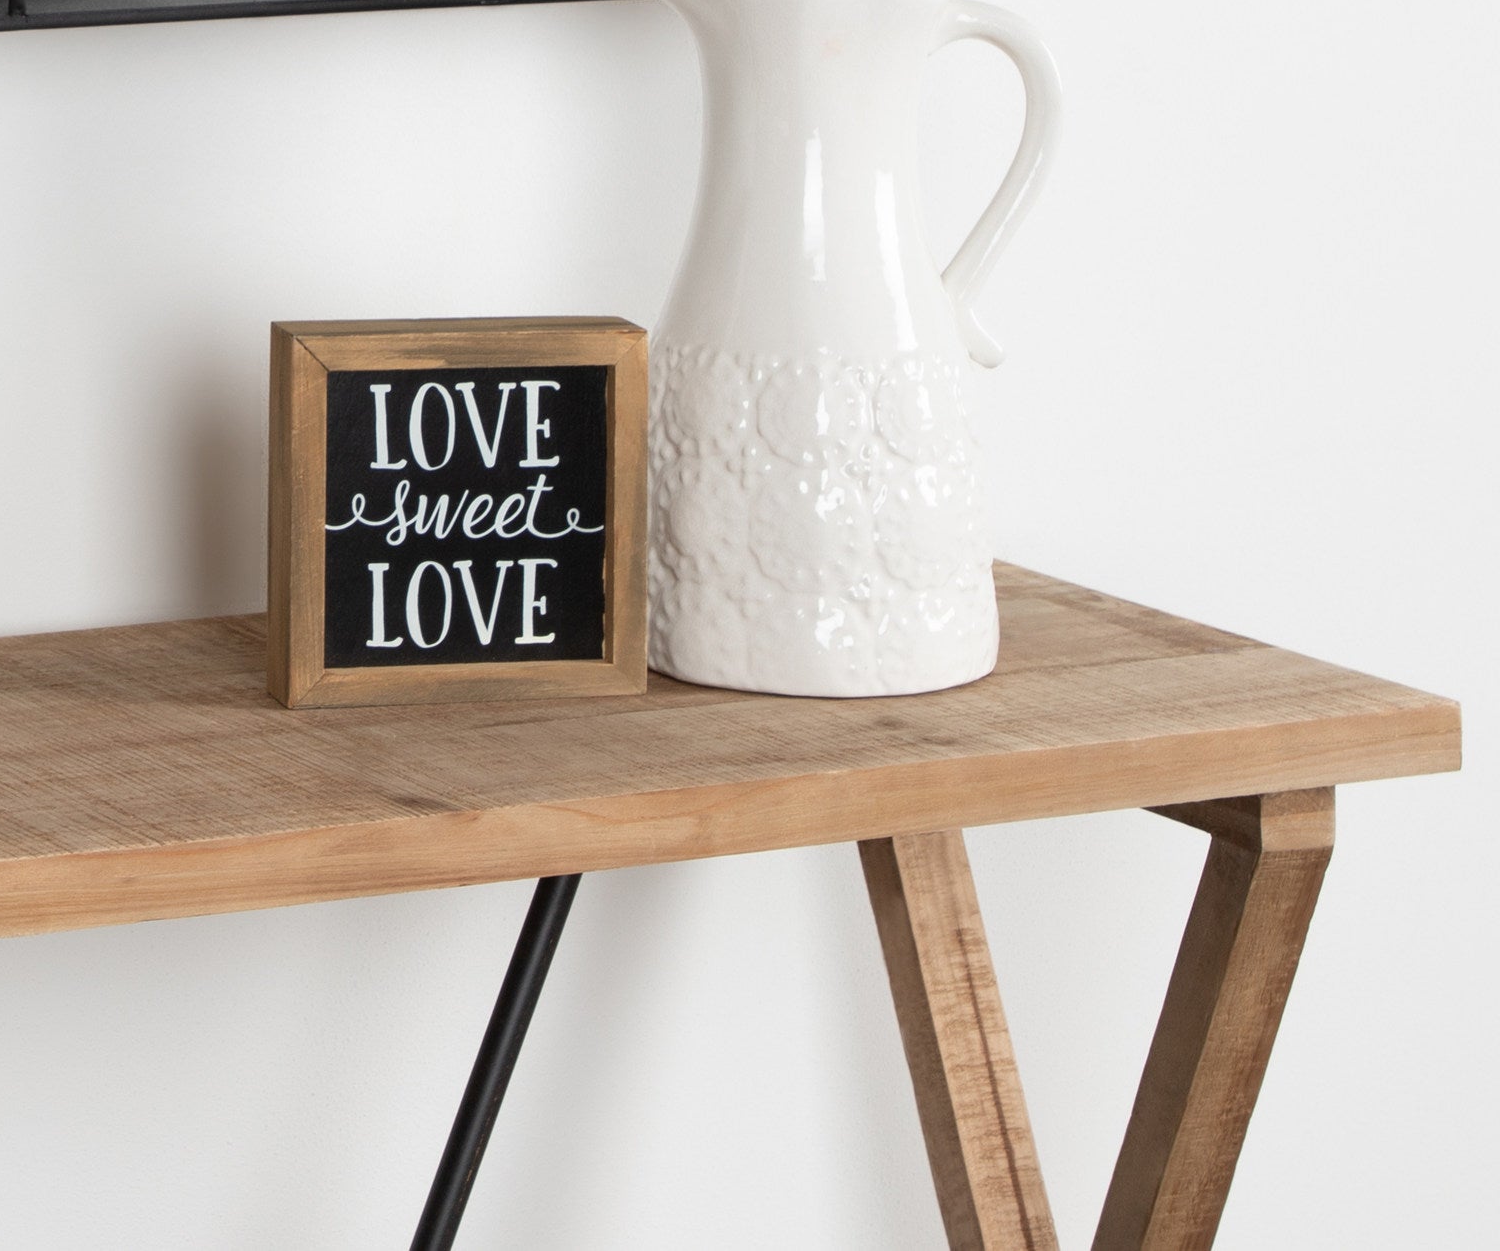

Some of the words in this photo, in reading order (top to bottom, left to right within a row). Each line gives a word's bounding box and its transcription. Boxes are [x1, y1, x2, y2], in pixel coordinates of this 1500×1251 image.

[369, 380, 561, 471] LOVE
[326, 473, 604, 546] sweet
[365, 558, 558, 649] LOVE
